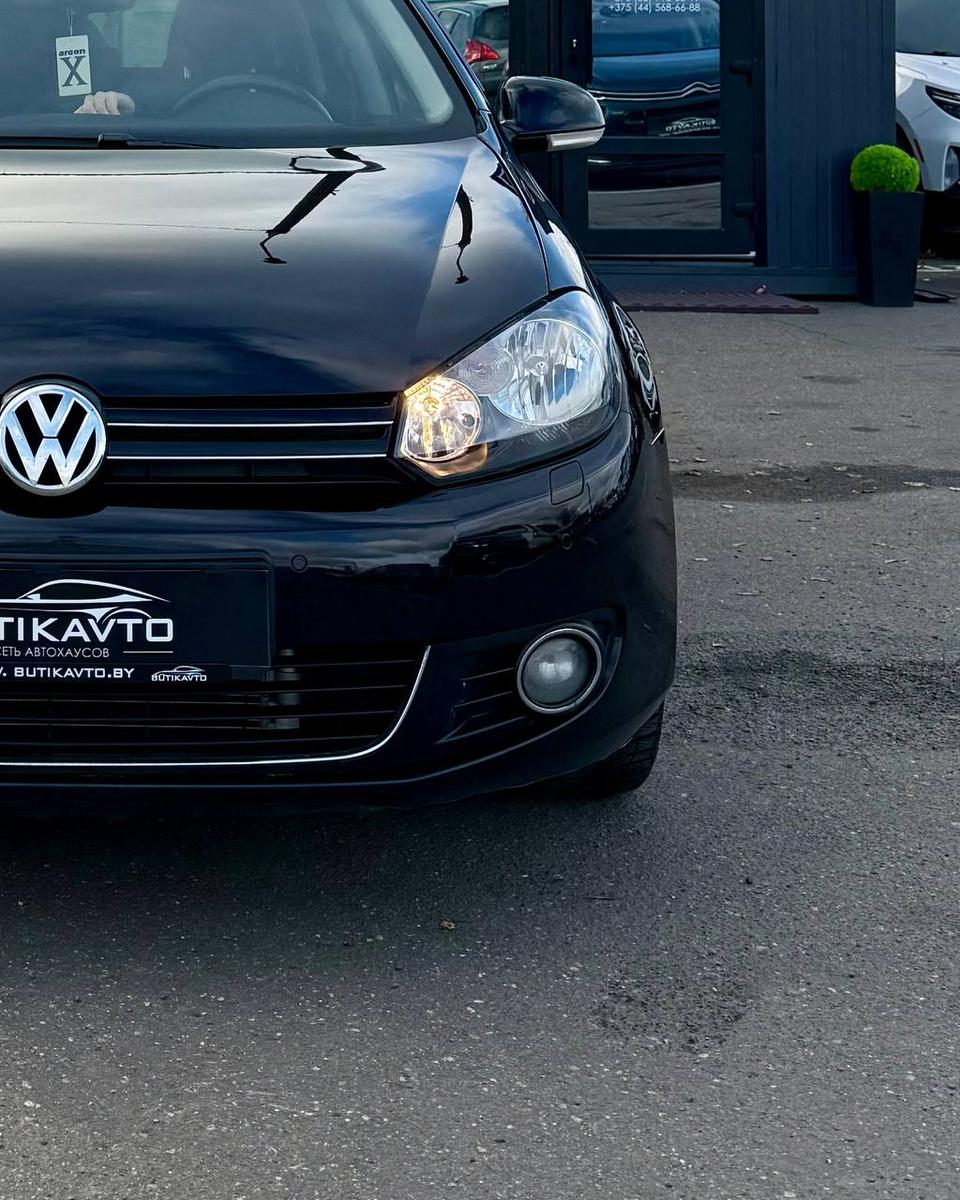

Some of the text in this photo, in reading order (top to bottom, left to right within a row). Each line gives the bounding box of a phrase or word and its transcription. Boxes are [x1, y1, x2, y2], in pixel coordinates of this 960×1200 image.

[609, 2, 701, 13] +375 (44) 568-66-88
[60, 55, 88, 87] X
[25, 647, 110, 658] АВТОХАУСОВ
[14, 667, 135, 679] BUTIKAVTO.BY
[151, 673, 207, 682] BUTIKAVTO
